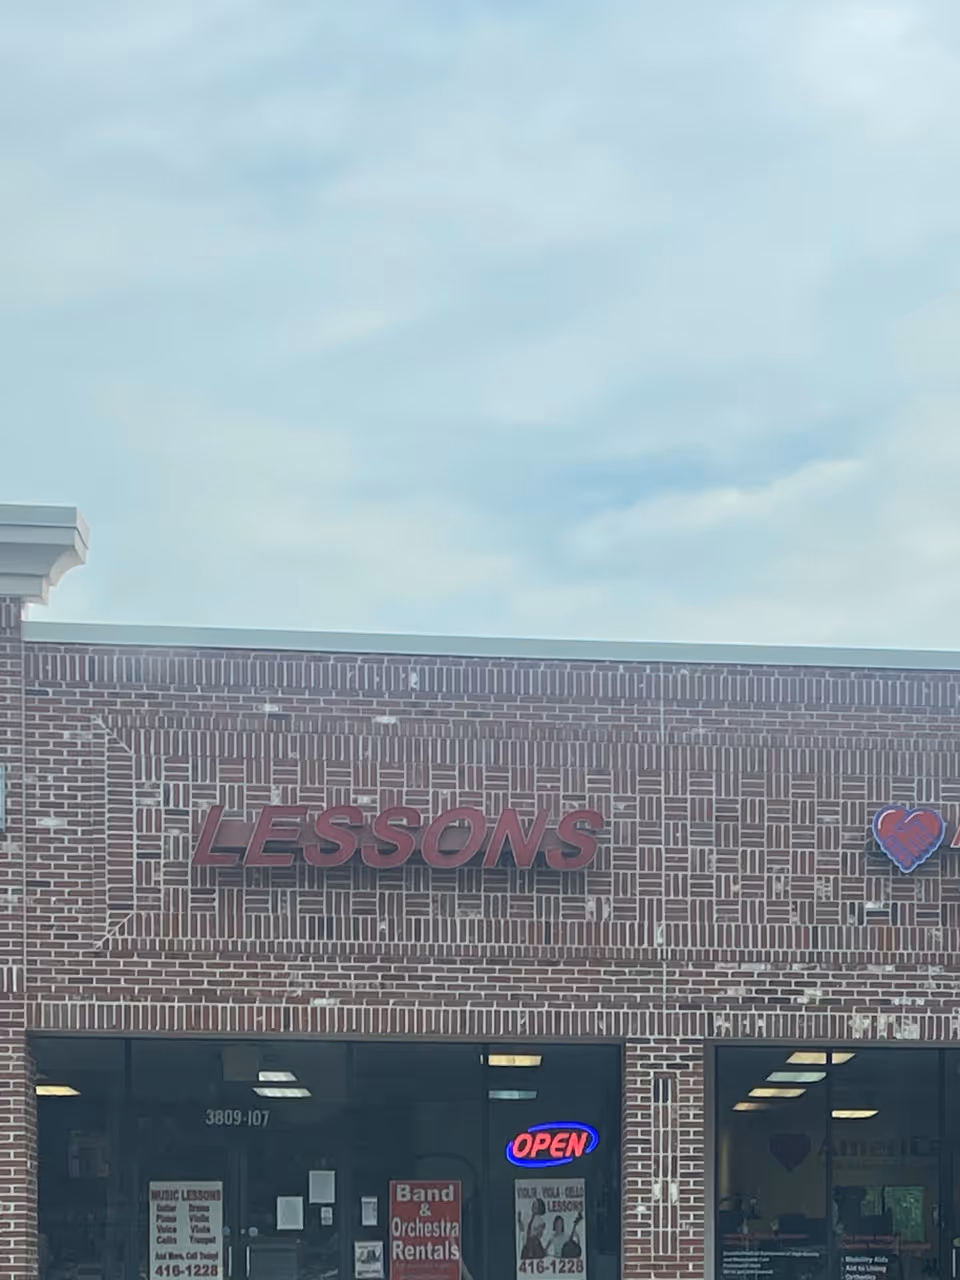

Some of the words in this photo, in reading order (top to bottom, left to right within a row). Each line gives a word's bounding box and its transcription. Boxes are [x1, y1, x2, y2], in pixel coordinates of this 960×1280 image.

[191, 803, 605, 870] LESSONS
[206, 1109, 270, 1126] 3809-107
[512, 1132, 588, 1158] OPEN
[151, 1190, 179, 1201] MUSIC
[181, 1190, 221, 1201] LESSONS
[396, 1184, 454, 1201] Band
[542, 1186, 560, 1198] VIOLA
[419, 1203, 432, 1216] &
[547, 1200, 584, 1212] LESSONS
[391, 1217, 459, 1237] Orchestra
[392, 1240, 460, 1260] Rentals
[155, 1264, 219, 1277] 416-1228
[518, 1260, 584, 1274] 416-1228
